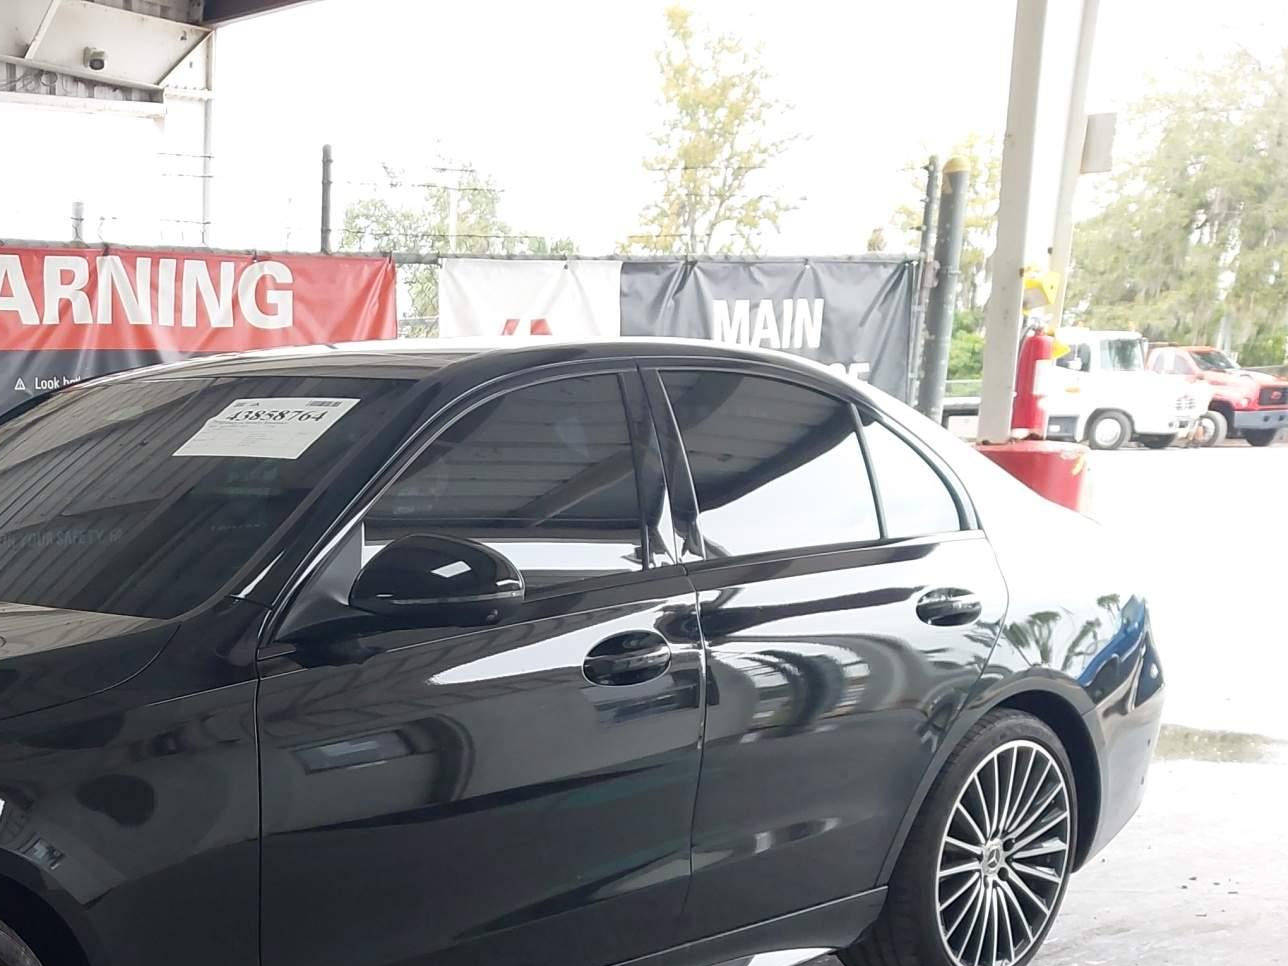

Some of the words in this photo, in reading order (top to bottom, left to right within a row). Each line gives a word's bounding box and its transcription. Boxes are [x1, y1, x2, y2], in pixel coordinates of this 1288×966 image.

[712, 298, 825, 349] MAIN
[34, 376, 60, 390] Look
[226, 410, 328, 422] 43858764
